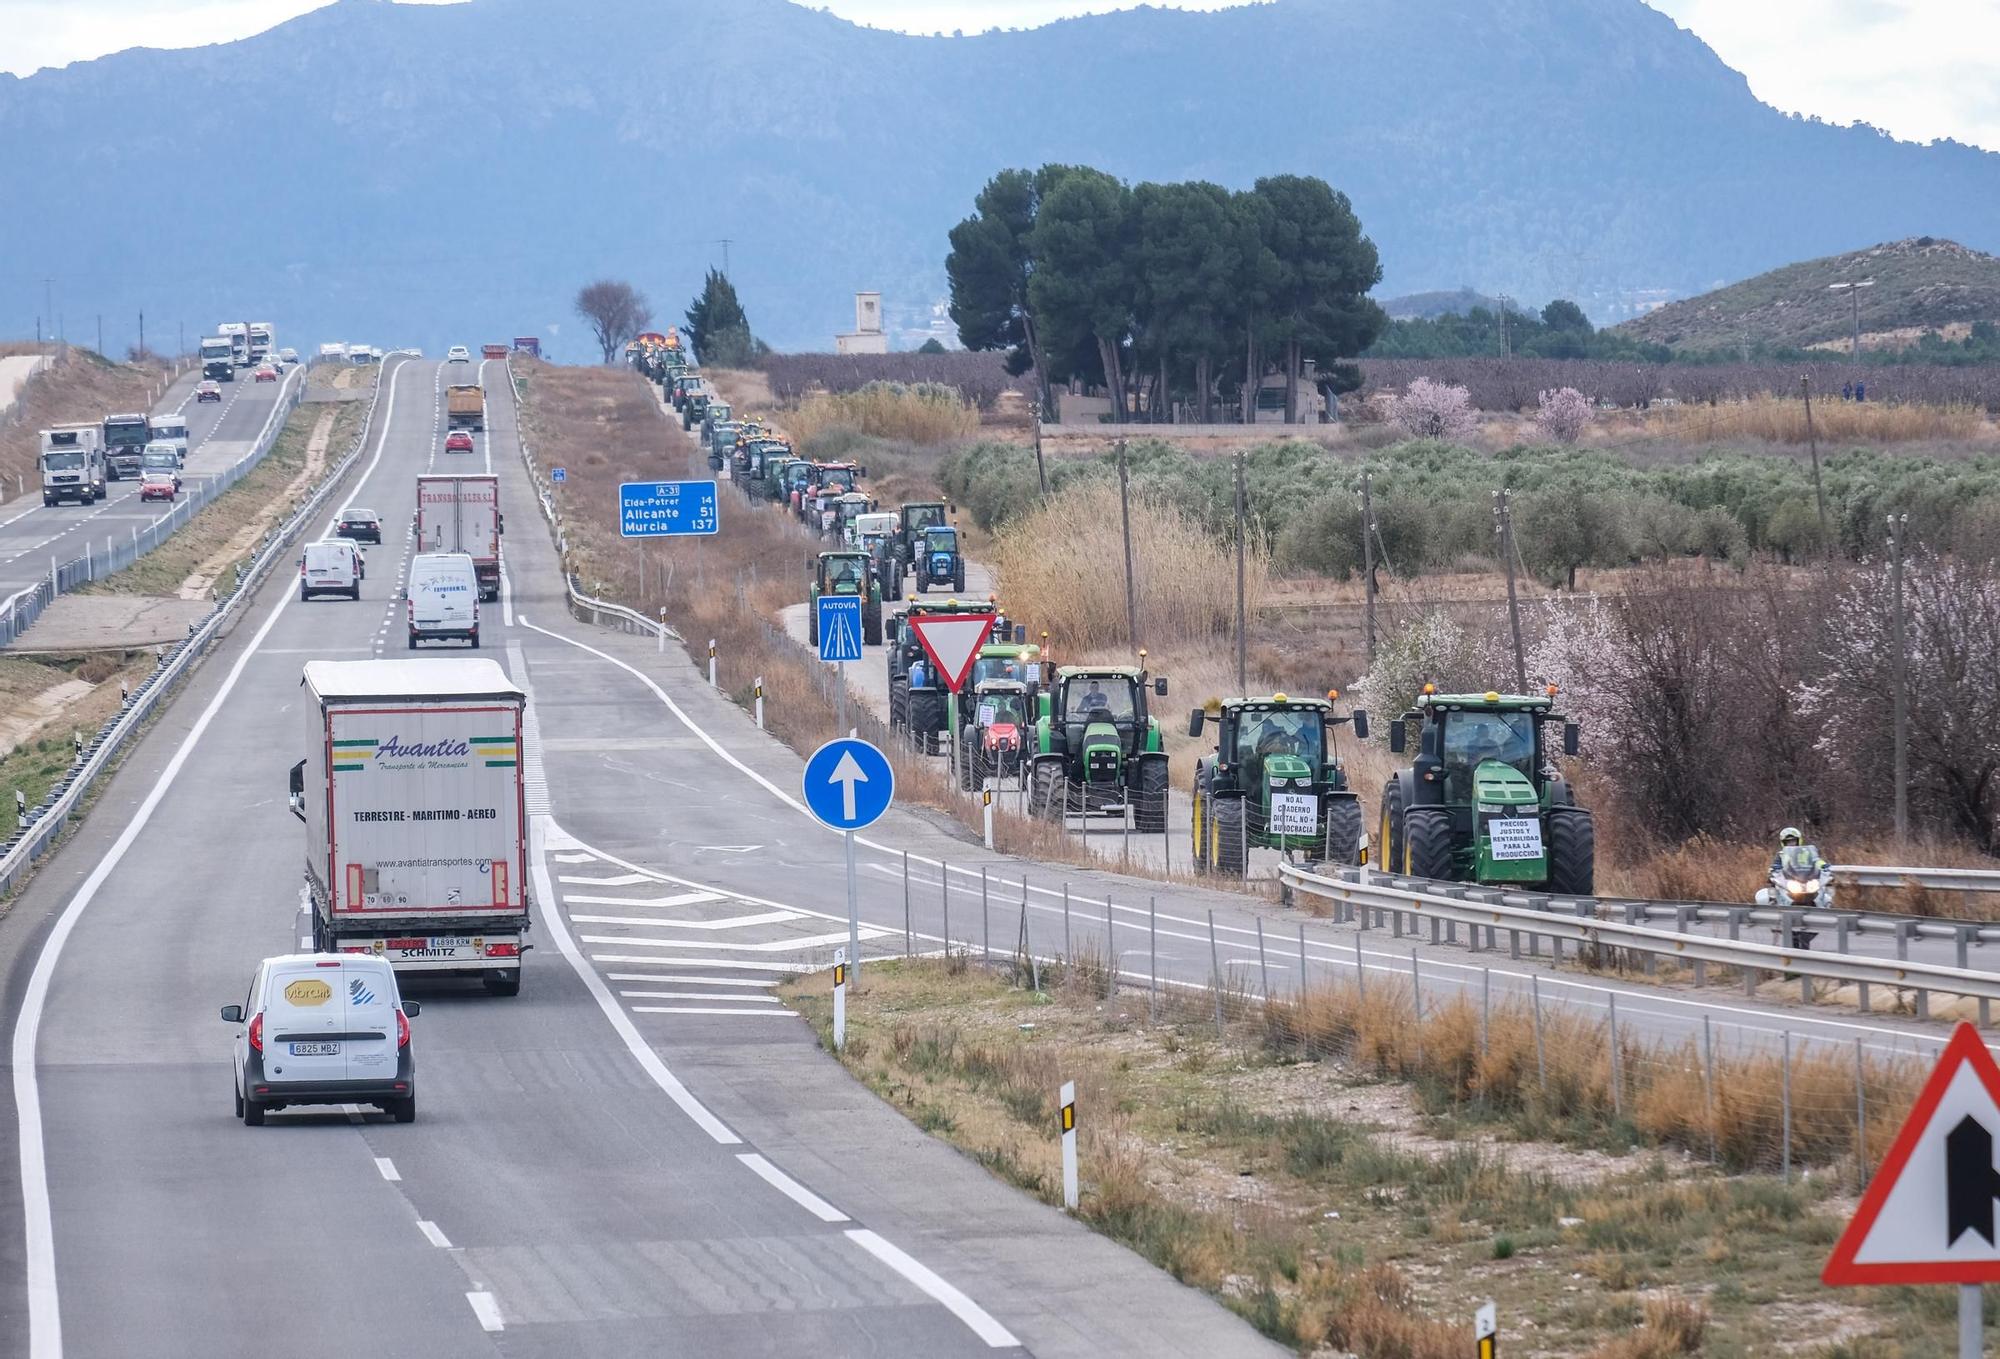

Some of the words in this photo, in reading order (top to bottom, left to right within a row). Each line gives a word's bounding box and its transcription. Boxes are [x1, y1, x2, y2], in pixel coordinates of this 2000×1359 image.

[658, 487, 678, 495] A-31
[624, 498, 680, 507] Elda-Petrer
[701, 496, 712, 504] 14
[625, 508, 679, 520] Alicante
[700, 507, 713, 517] 51
[625, 521, 668, 532] Murcia
[692, 519, 714, 530] 137
[822, 601, 857, 610] AUTOVÍA
[375, 735, 470, 759] Avantia
[1278, 804, 1310, 814] CADERNO
[354, 812, 405, 822] TERRESTRE
[402, 948, 454, 958] SCHMITZ
[296, 1044, 318, 1053] 6825
